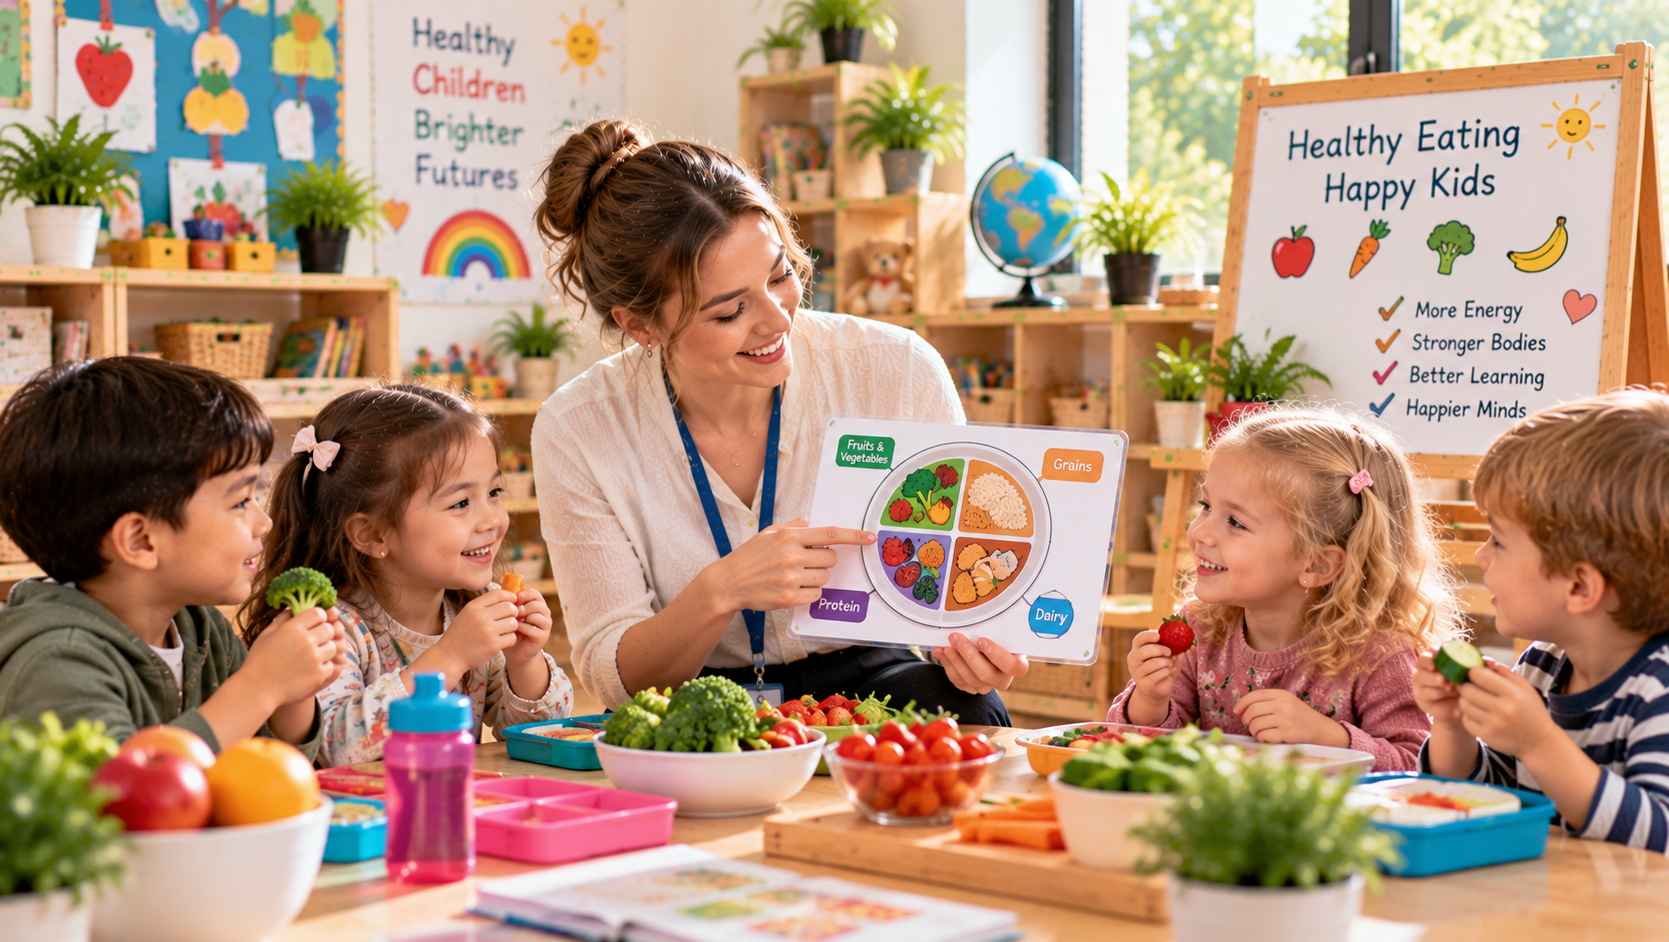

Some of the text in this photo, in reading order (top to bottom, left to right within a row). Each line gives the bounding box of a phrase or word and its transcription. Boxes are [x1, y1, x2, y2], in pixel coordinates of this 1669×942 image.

[412, 17, 515, 66] Healthy
[412, 62, 526, 104] Children
[414, 109, 524, 152] Brighter
[1288, 118, 1521, 165] Healthy Eating
[415, 154, 518, 190] Futures
[1324, 163, 1496, 212] Happy Kids
[1415, 300, 1523, 324] More Energy
[1412, 333, 1547, 357] Stronger Bodies
[1409, 366, 1545, 391] Better Learning
[1406, 398, 1527, 422] Happier Minds
[847, 439, 885, 453] Fruits &
[840, 452, 888, 465] Vegetables
[1053, 458, 1093, 473] Grains
[818, 598, 861, 613] Protein
[1035, 607, 1068, 626] Dairy
